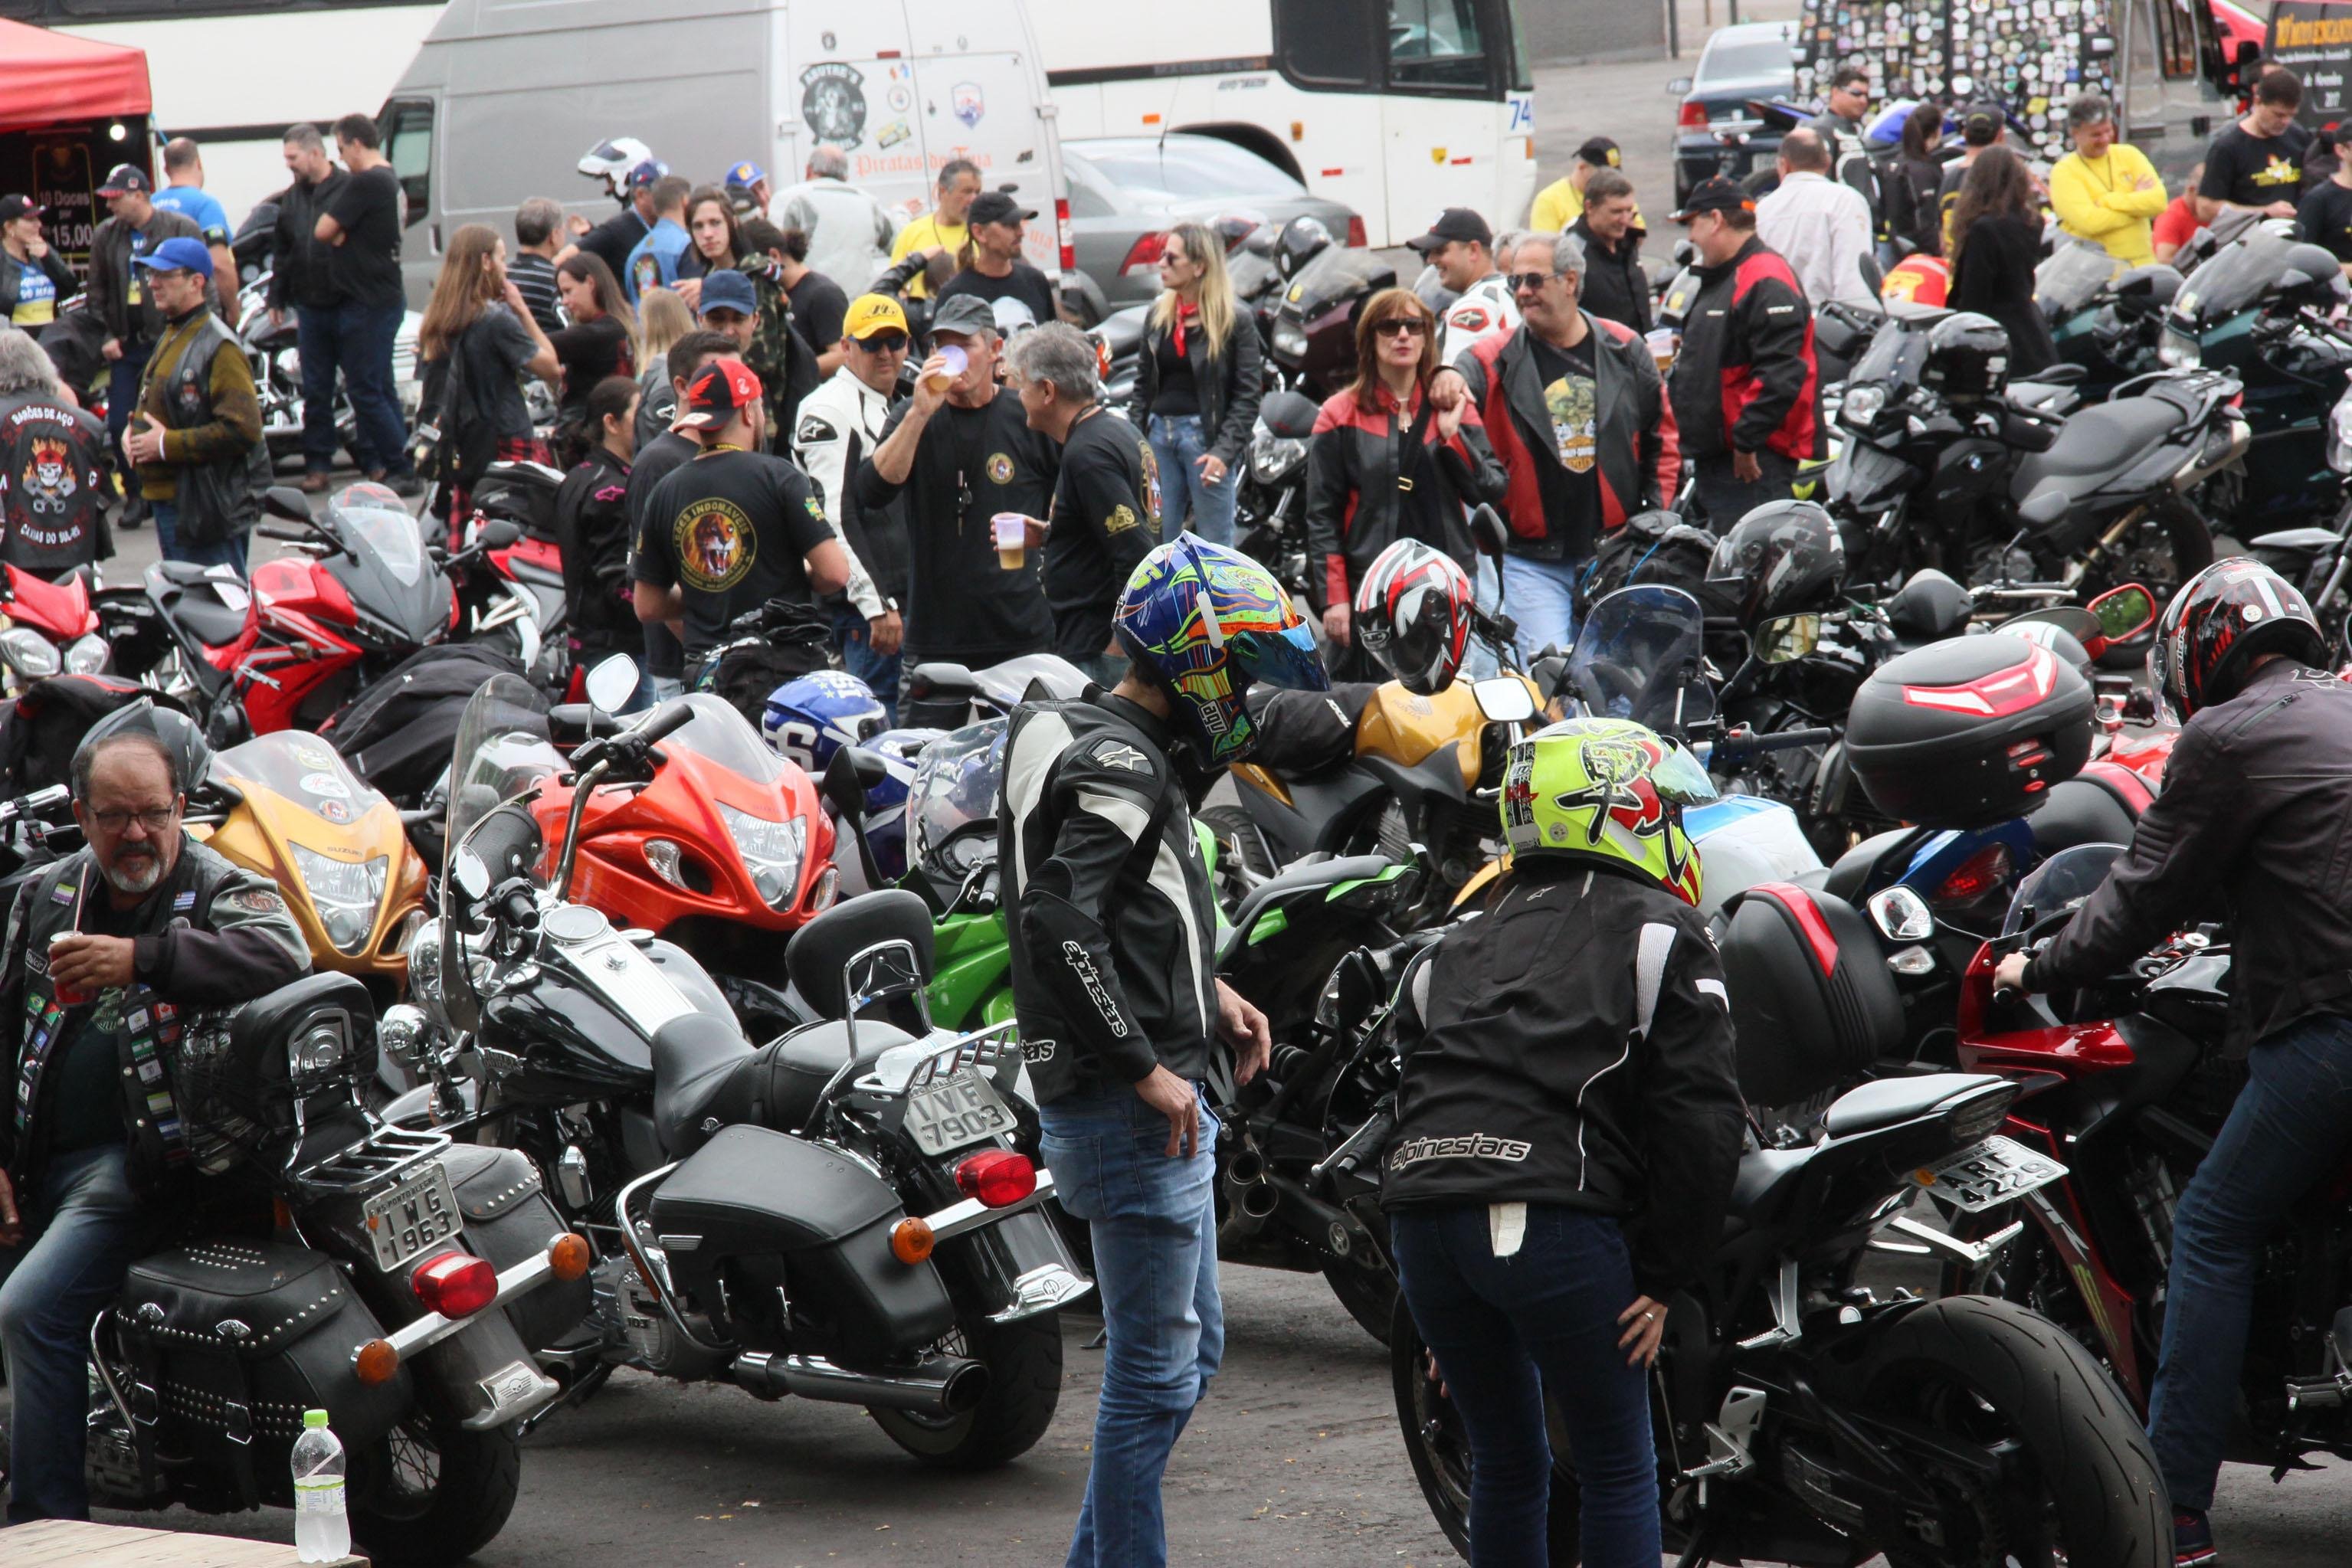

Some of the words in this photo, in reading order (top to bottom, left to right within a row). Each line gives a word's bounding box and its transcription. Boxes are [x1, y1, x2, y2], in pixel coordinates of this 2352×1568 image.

[54, 191, 90, 206] Doces
[52, 224, 92, 250] 15,00
[44, 407, 55, 421] DE
[56, 411, 74, 427] AÇO
[88, 470, 98, 488] G
[46, 532, 57, 545] DO
[1062, 940, 1129, 1038] alpinestars
[921, 1104, 1006, 1147] 7903
[1390, 1132, 1532, 1171] alpinestars
[1959, 1159, 2060, 1205] 4229
[389, 1209, 451, 1262] 1963
